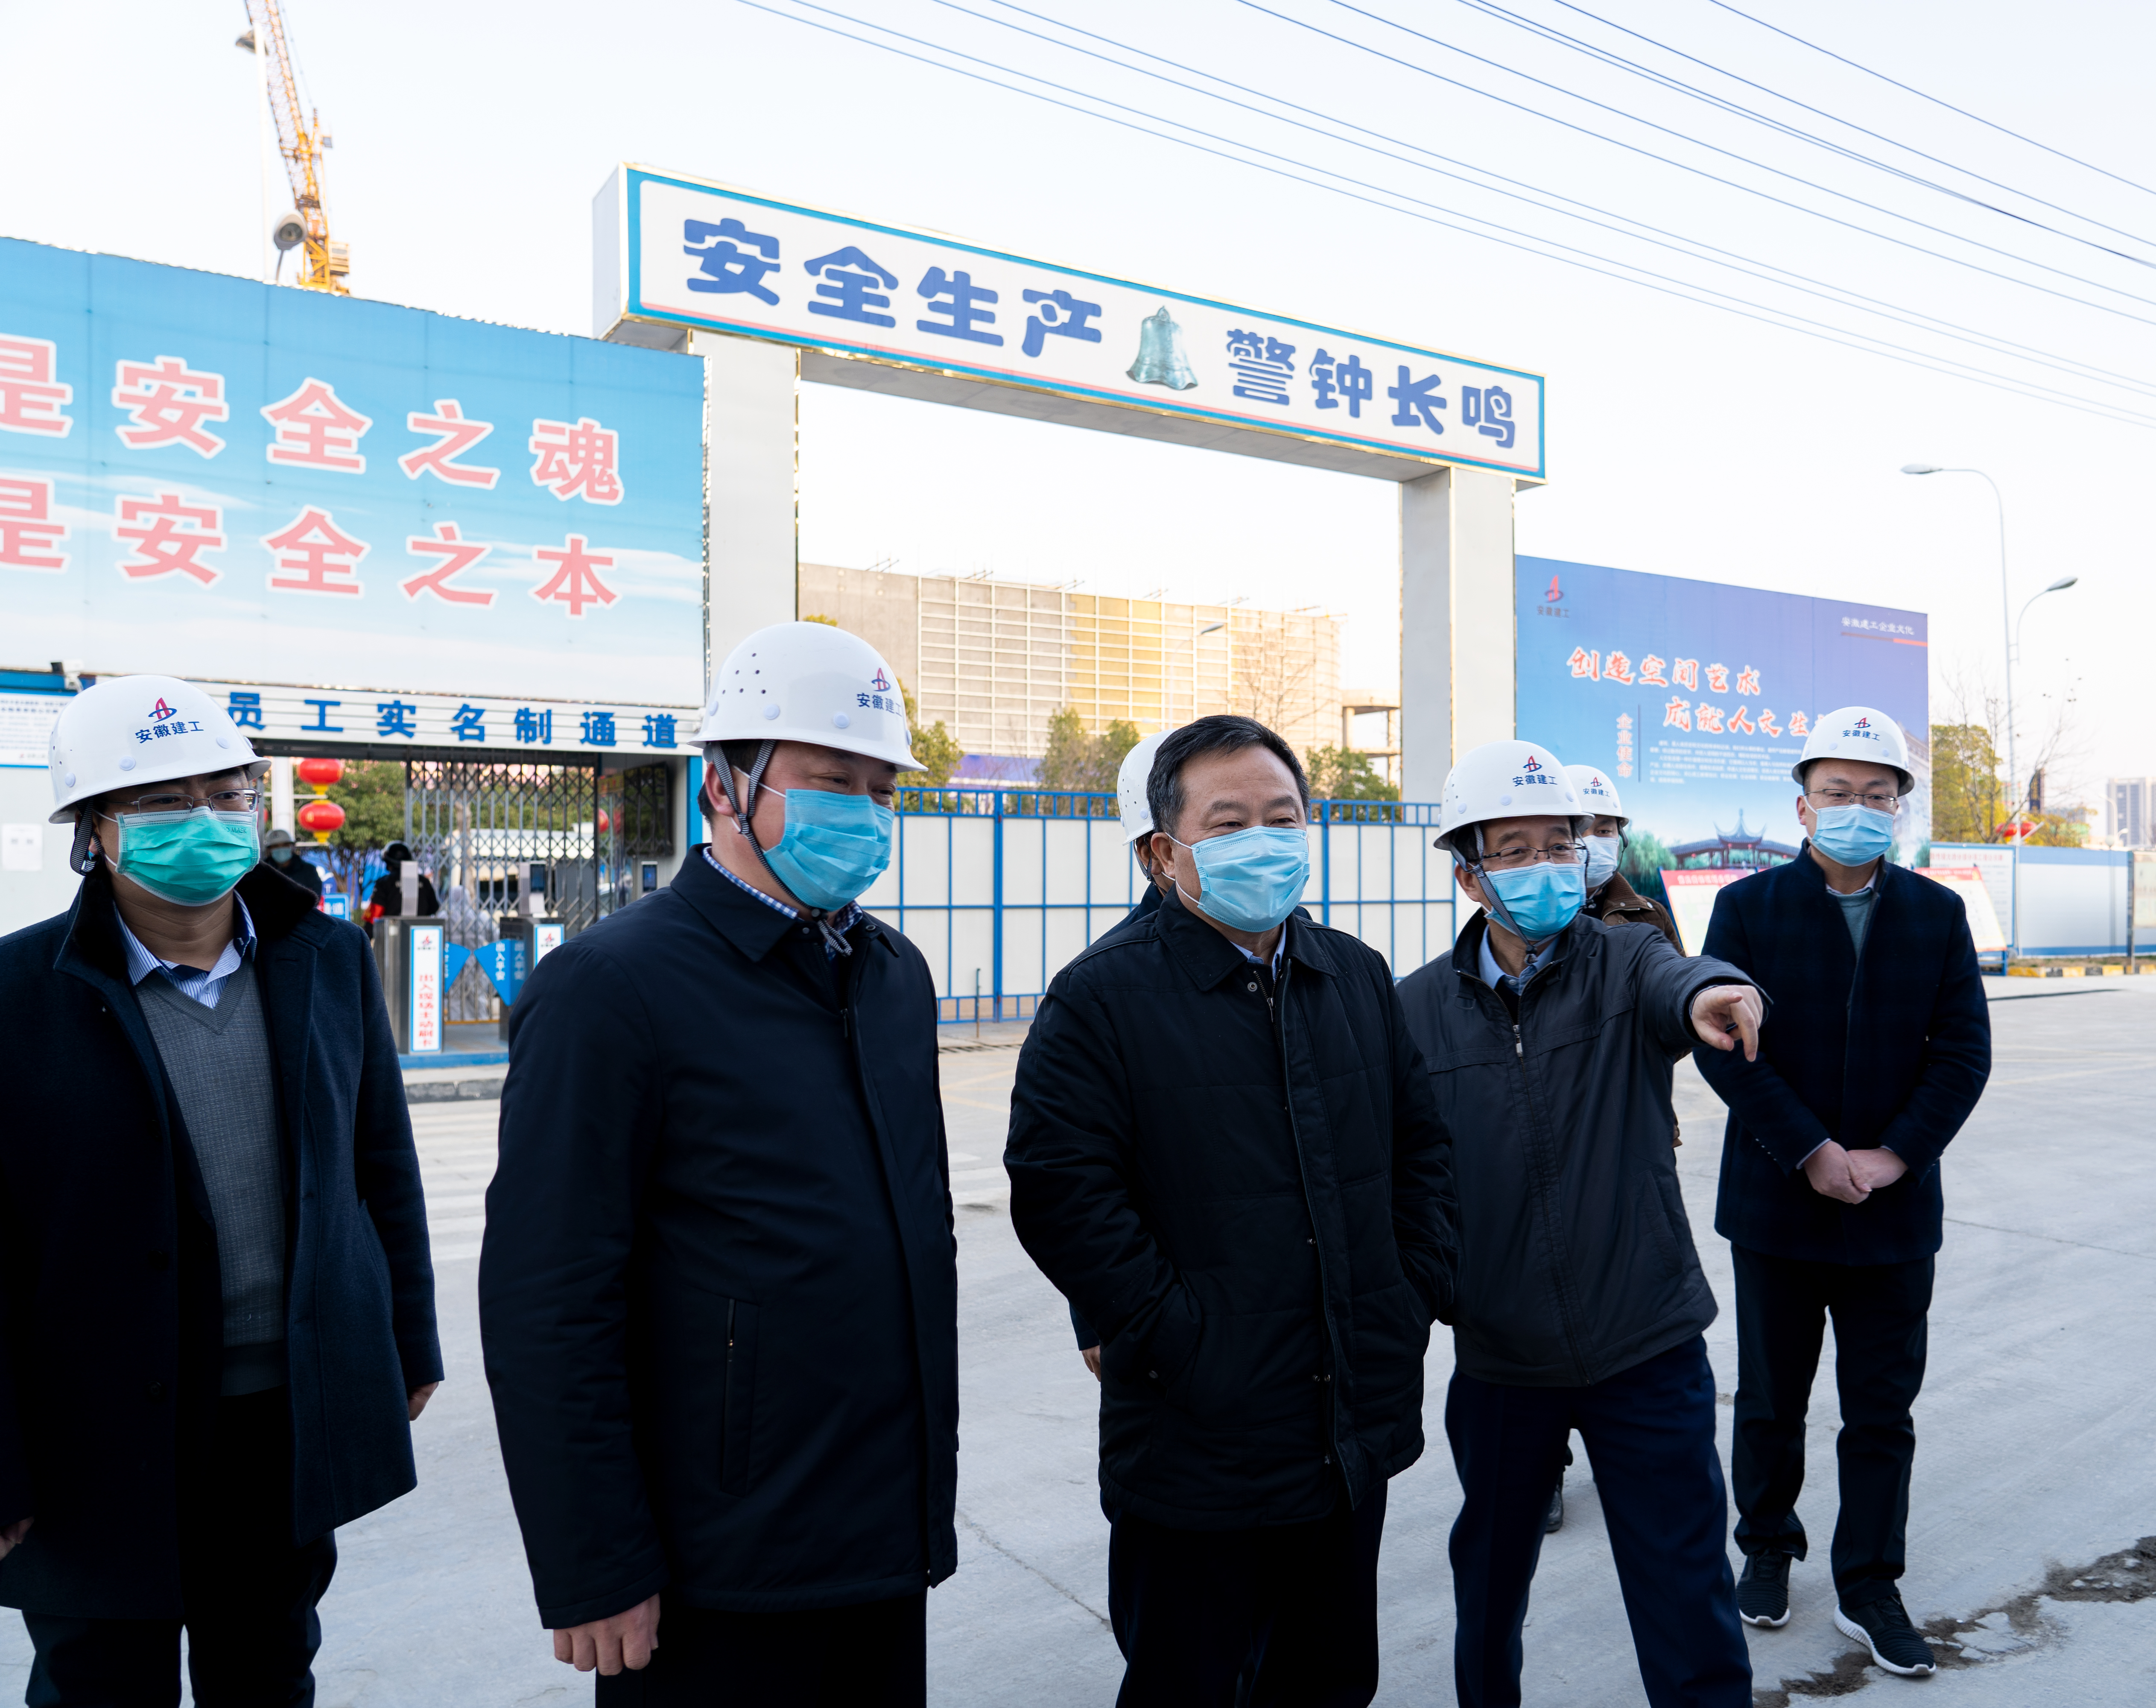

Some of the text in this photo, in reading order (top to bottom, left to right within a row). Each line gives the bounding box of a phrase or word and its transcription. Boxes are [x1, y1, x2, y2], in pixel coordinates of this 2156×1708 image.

[684, 217, 1515, 448] 安全生产 警钟长鸣
[0, 334, 623, 505] 是安全之魂
[0, 478, 618, 617] 是安全之本
[1537, 605, 1570, 618] 安徽建工
[1841, 616, 1915, 635] 安徽建工企业文化
[1566, 646, 1761, 696] 创造空间艺术
[228, 692, 678, 749] 员工实名制通道
[857, 692, 903, 717] 安徽建工
[1663, 696, 1826, 738] 成就人文生
[135, 721, 204, 743] 安徽建工
[1616, 712, 1633, 778] 企业使命
[1842, 730, 1880, 741] 安徽建工
[1513, 775, 1558, 787] 安徽建工
[1583, 788, 1610, 797] 安徽建工
